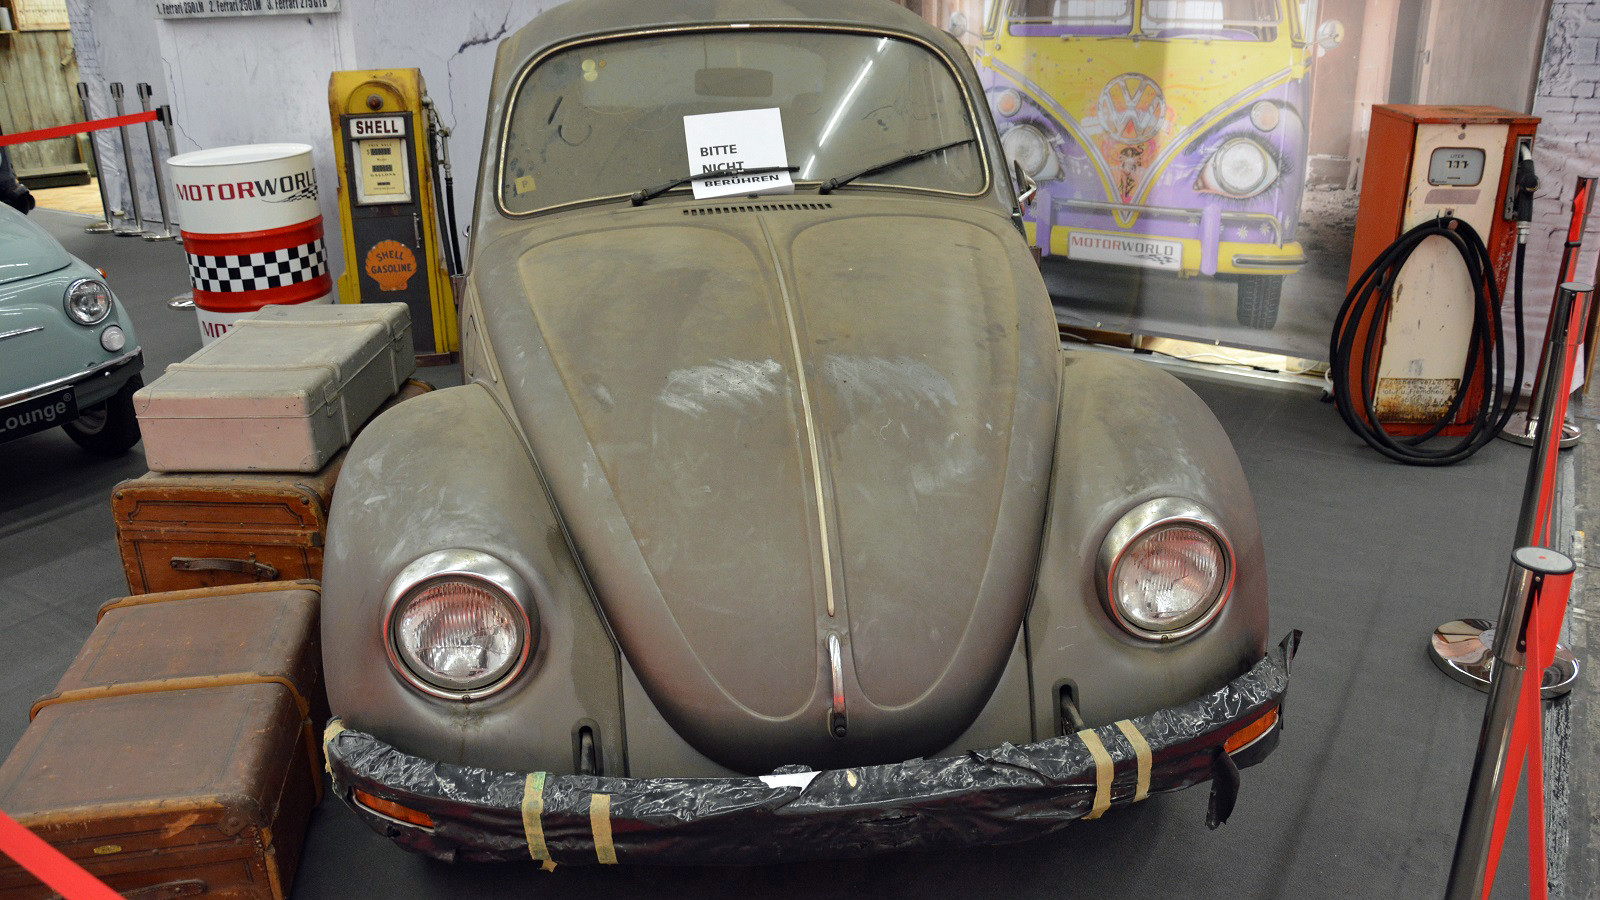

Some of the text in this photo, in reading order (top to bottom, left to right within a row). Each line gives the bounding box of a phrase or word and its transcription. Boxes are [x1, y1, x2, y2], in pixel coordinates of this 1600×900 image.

[162, 3, 183, 15] Ferrari
[217, 0, 239, 12] Ferrari
[356, 120, 399, 134] SHELL
[700, 144, 737, 157] BITTE
[702, 161, 744, 174] NICHT
[705, 174, 779, 187] BERÜHREN
[1071, 236, 1174, 256] MOTORWORLD
[376, 250, 403, 262] SHELL
[371, 263, 412, 274] GASOLINE
